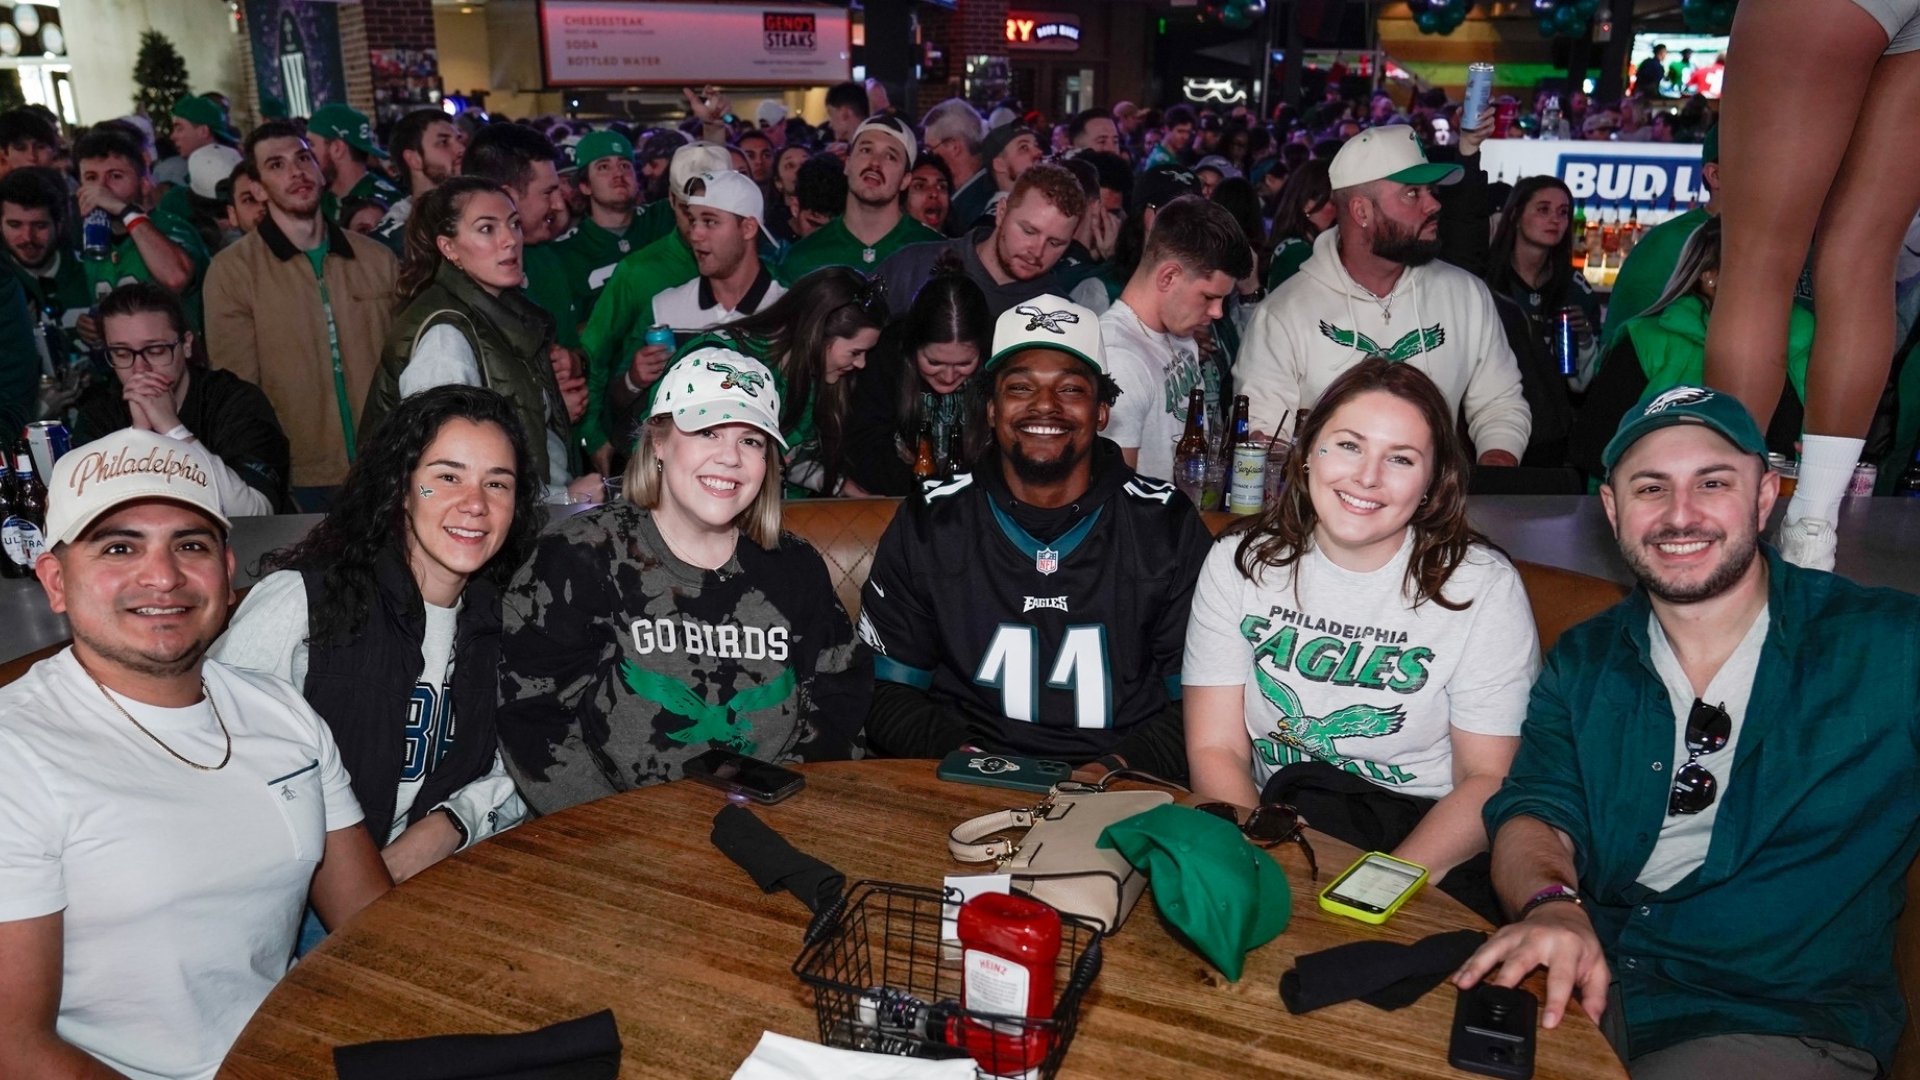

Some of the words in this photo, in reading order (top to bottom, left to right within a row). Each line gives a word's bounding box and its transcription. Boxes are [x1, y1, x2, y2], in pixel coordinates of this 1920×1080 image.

[566, 40, 598, 50] SODA
[767, 32, 814, 48] STEAKS
[568, 56, 619, 66] BOTTLED
[623, 56, 661, 66] WATER
[1564, 162, 1668, 200] BUD
[69, 446, 208, 497] Philadelphia
[1023, 596, 1068, 612] EAGLES
[631, 618, 677, 655] GO
[682, 620, 788, 661] BIRDS
[1269, 605, 1408, 644] PHILADELPHIA
[1240, 614, 1436, 694] EAGLES
[974, 623, 1113, 729] 11
[979, 960, 1007, 976] HEINZ
